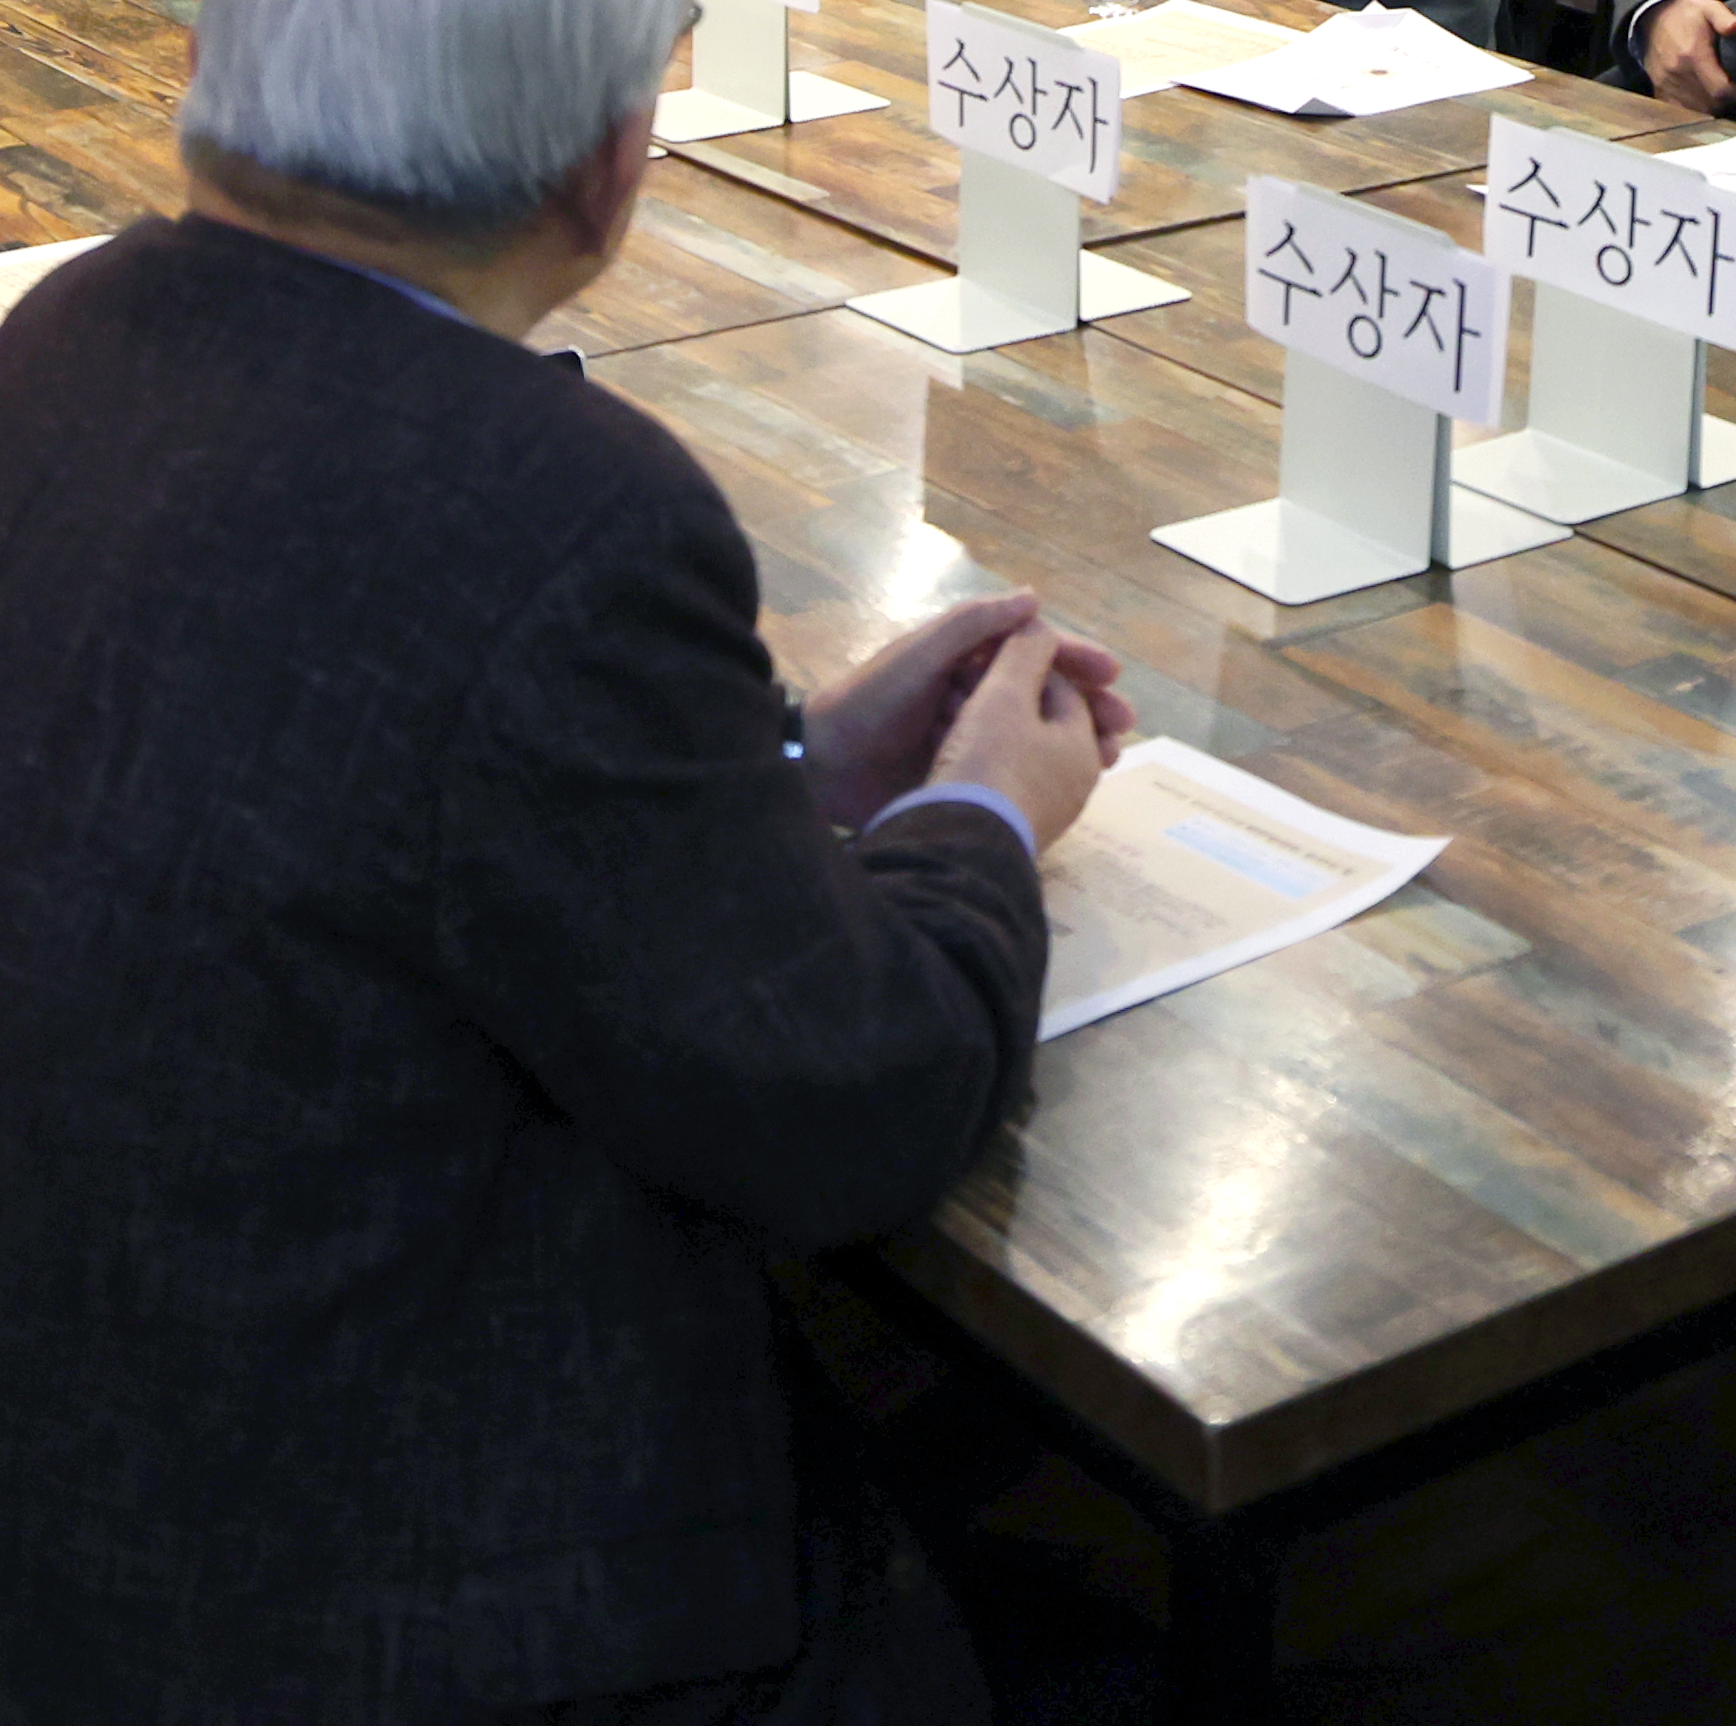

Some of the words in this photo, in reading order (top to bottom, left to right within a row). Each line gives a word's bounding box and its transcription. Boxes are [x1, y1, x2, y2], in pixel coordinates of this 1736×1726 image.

[938, 39, 1110, 173] 수상자
[1257, 220, 1481, 394] 수상자
[1498, 159, 1734, 316] 수상자
